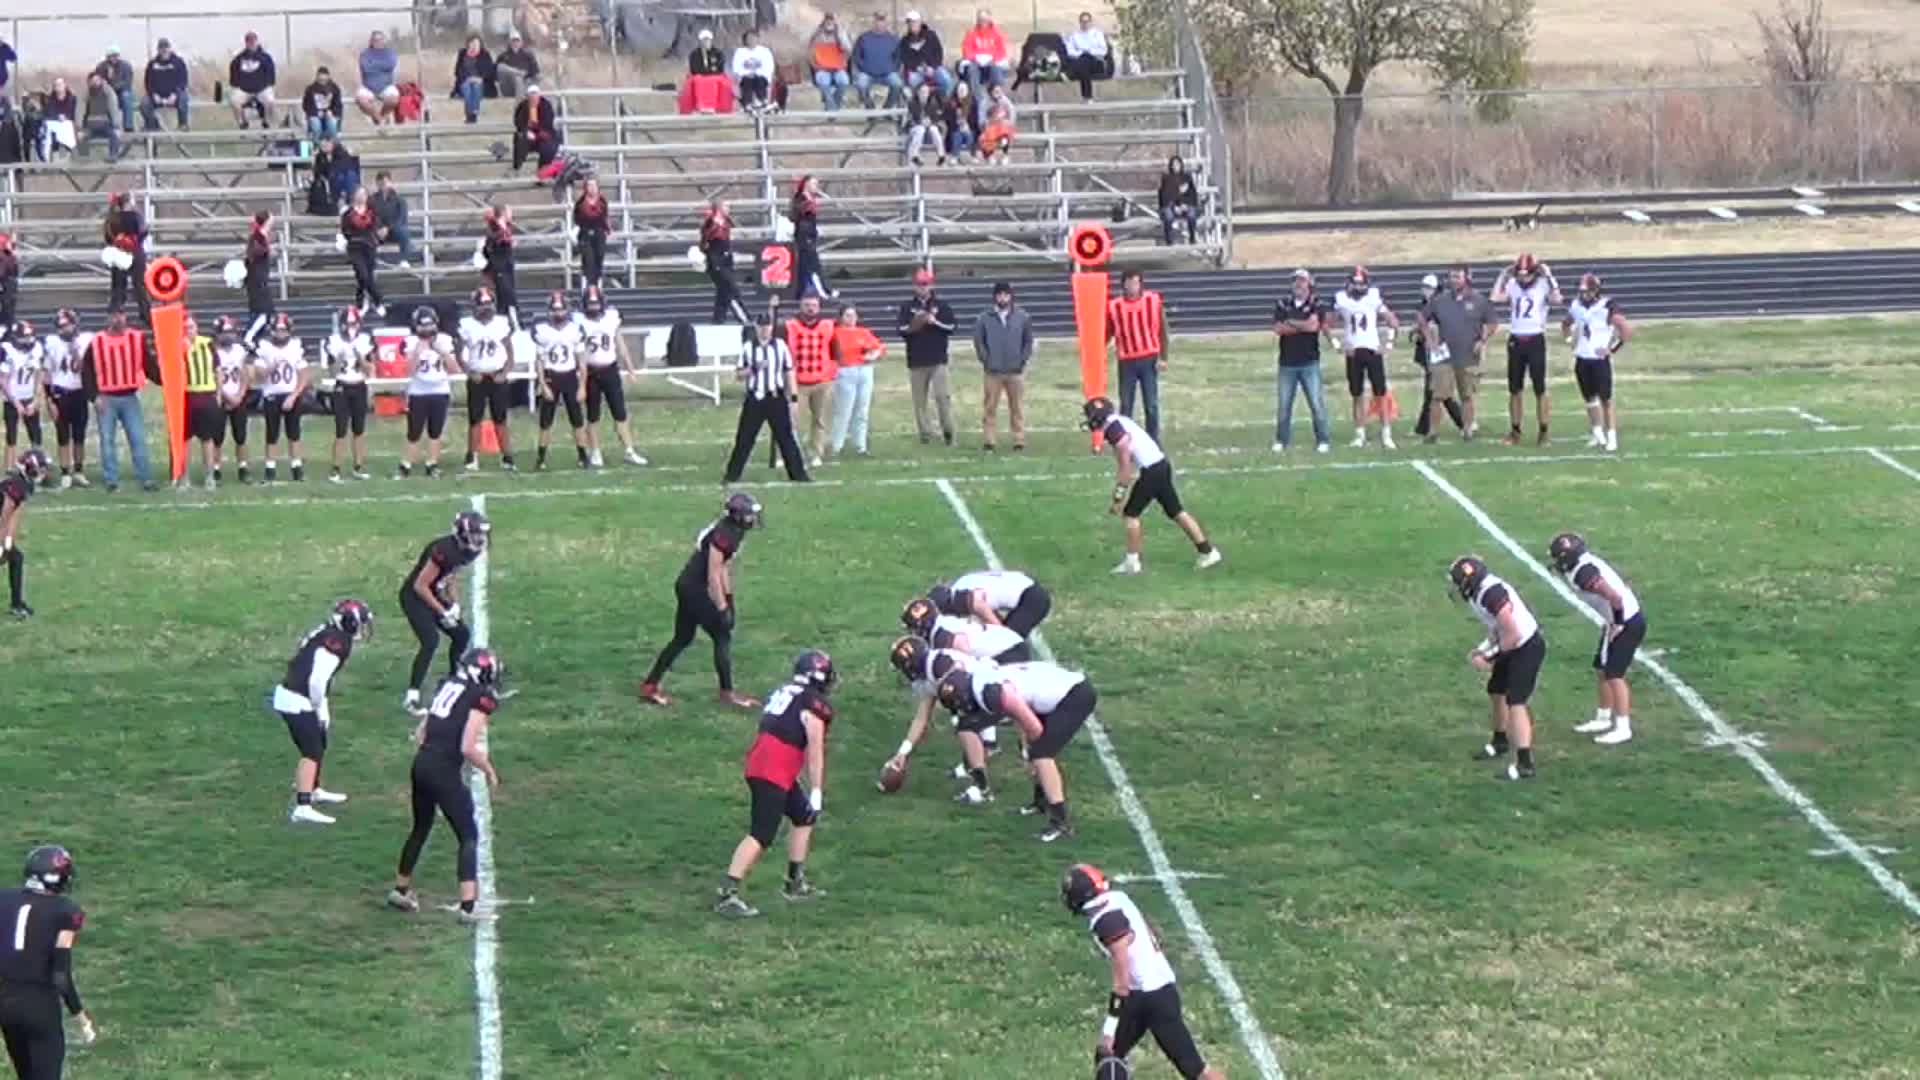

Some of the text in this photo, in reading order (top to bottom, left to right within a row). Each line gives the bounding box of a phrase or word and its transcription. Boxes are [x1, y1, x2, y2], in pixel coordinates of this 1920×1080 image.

[761, 245, 791, 286] 2
[1514, 297, 1534, 320] 12
[1349, 311, 1368, 334] 14
[549, 343, 569, 364] 63
[17, 365, 35, 386] 17
[270, 361, 293, 385] 60
[14, 903, 33, 950] 1
